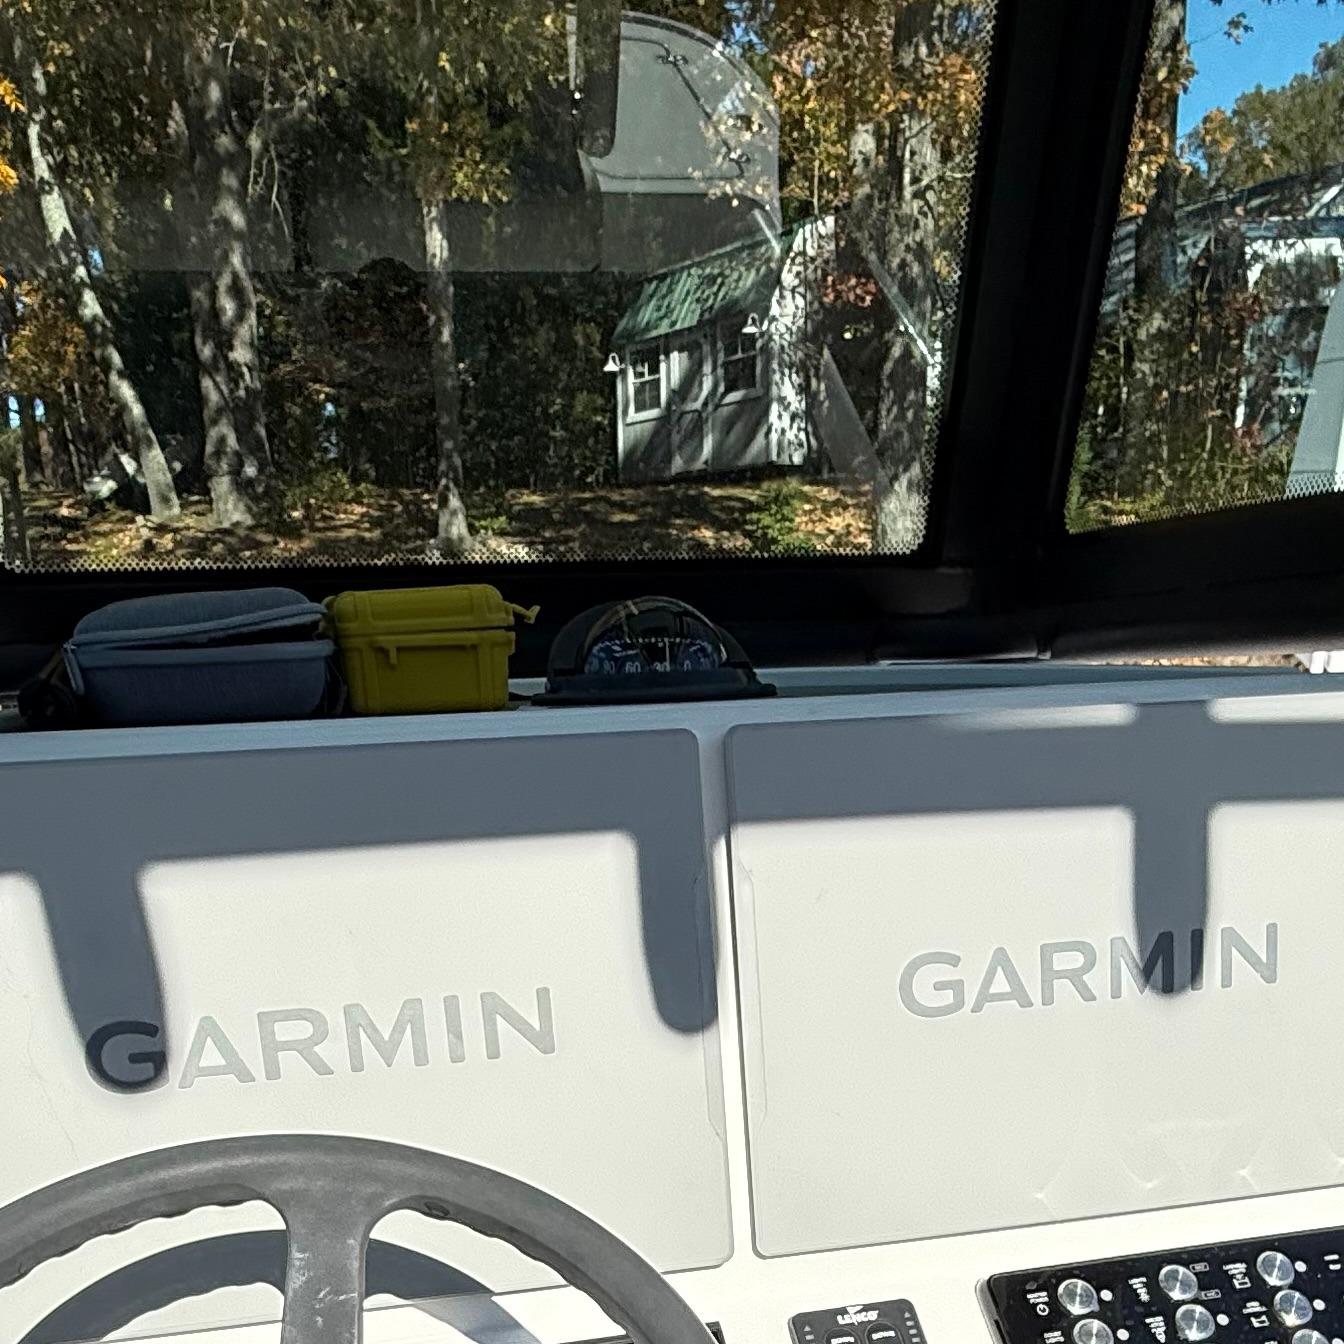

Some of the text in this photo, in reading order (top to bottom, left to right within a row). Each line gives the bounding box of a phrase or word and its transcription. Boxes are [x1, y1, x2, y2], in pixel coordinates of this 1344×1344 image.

[897, 921, 1280, 1019] GARMIN
[84, 986, 557, 1095] GARMIN
[836, 1309, 880, 1325] LENCO
